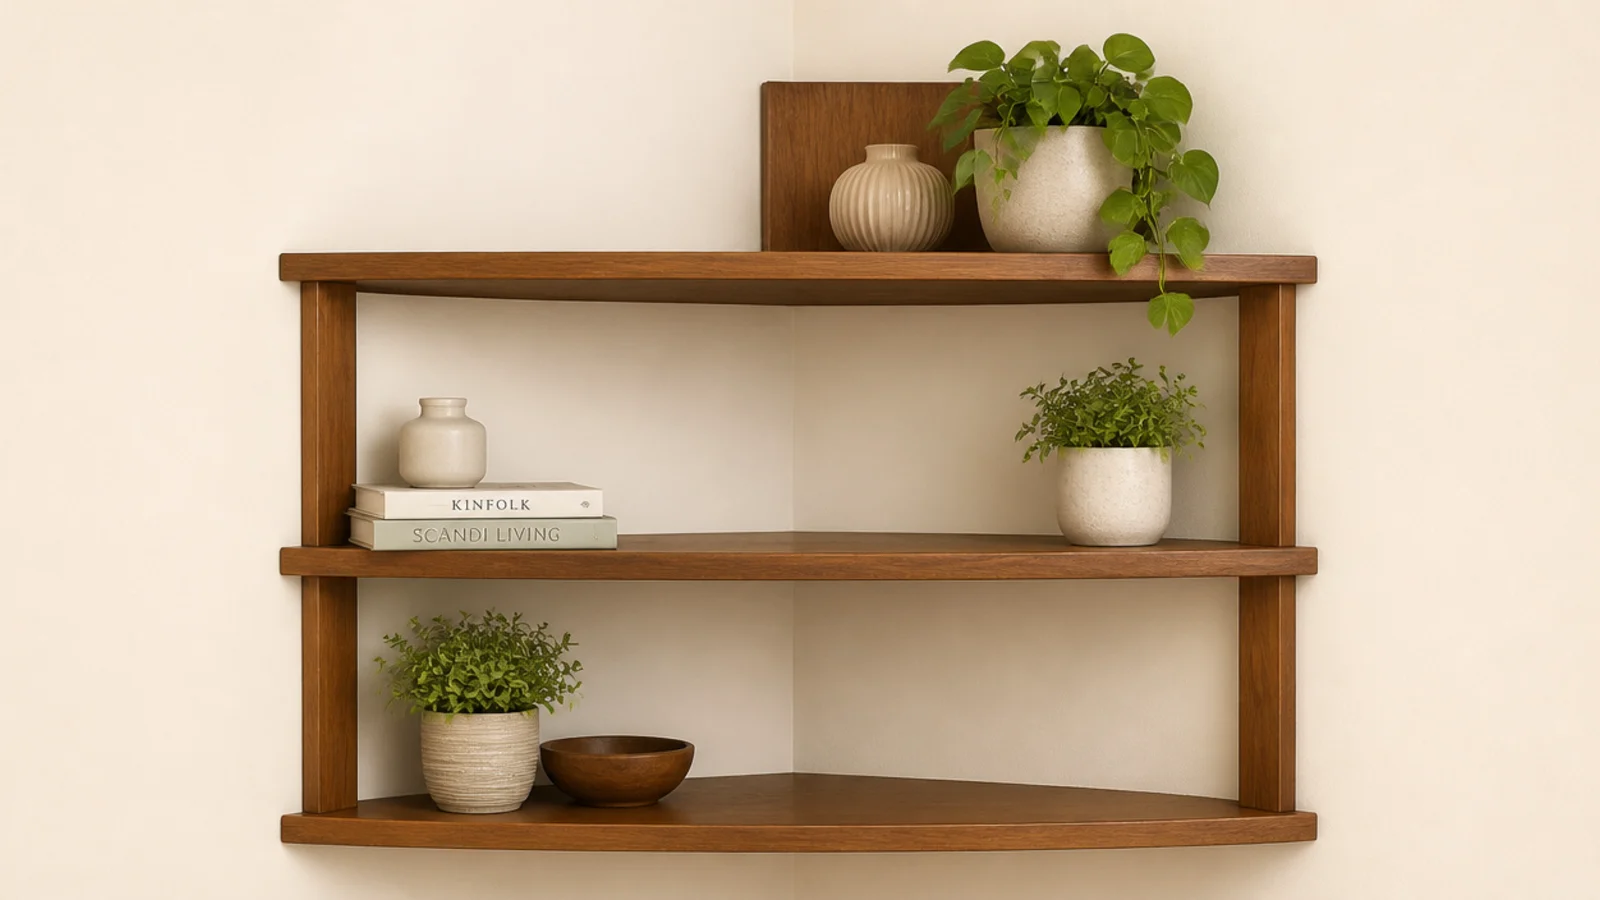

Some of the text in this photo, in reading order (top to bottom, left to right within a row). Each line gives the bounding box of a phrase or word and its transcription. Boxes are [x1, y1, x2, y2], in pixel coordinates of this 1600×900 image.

[451, 499, 531, 511] KINFOLK
[412, 527, 560, 543] SCANDI LIVING
